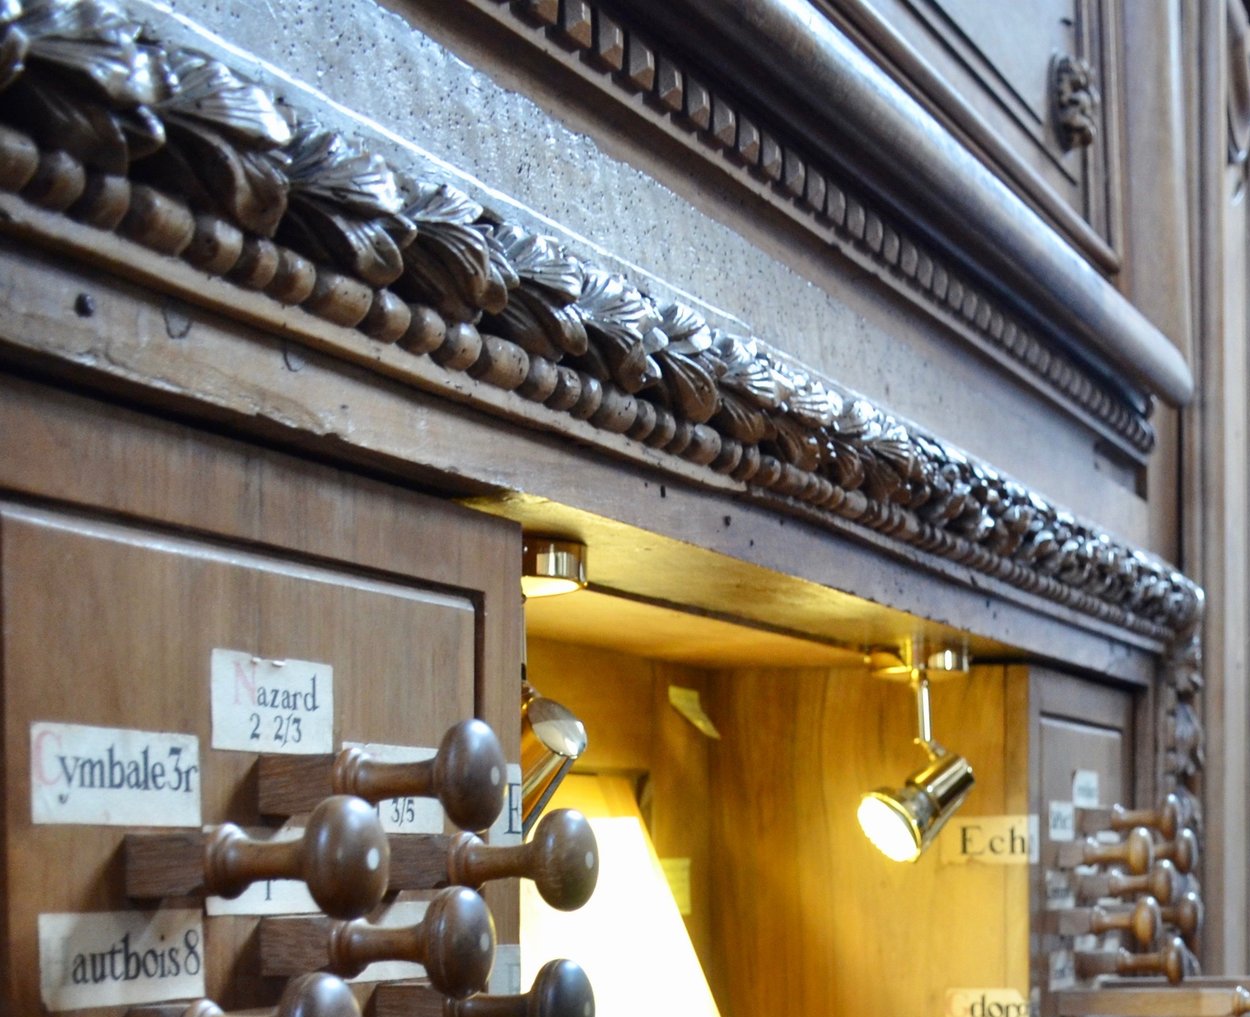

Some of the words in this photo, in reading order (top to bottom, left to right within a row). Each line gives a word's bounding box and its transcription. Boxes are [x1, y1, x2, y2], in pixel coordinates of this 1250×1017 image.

[232, 661, 319, 712] Nazard
[249, 712, 261, 740] 2
[273, 712, 302, 748] 2/3
[961, 825, 1034, 855] Ech
